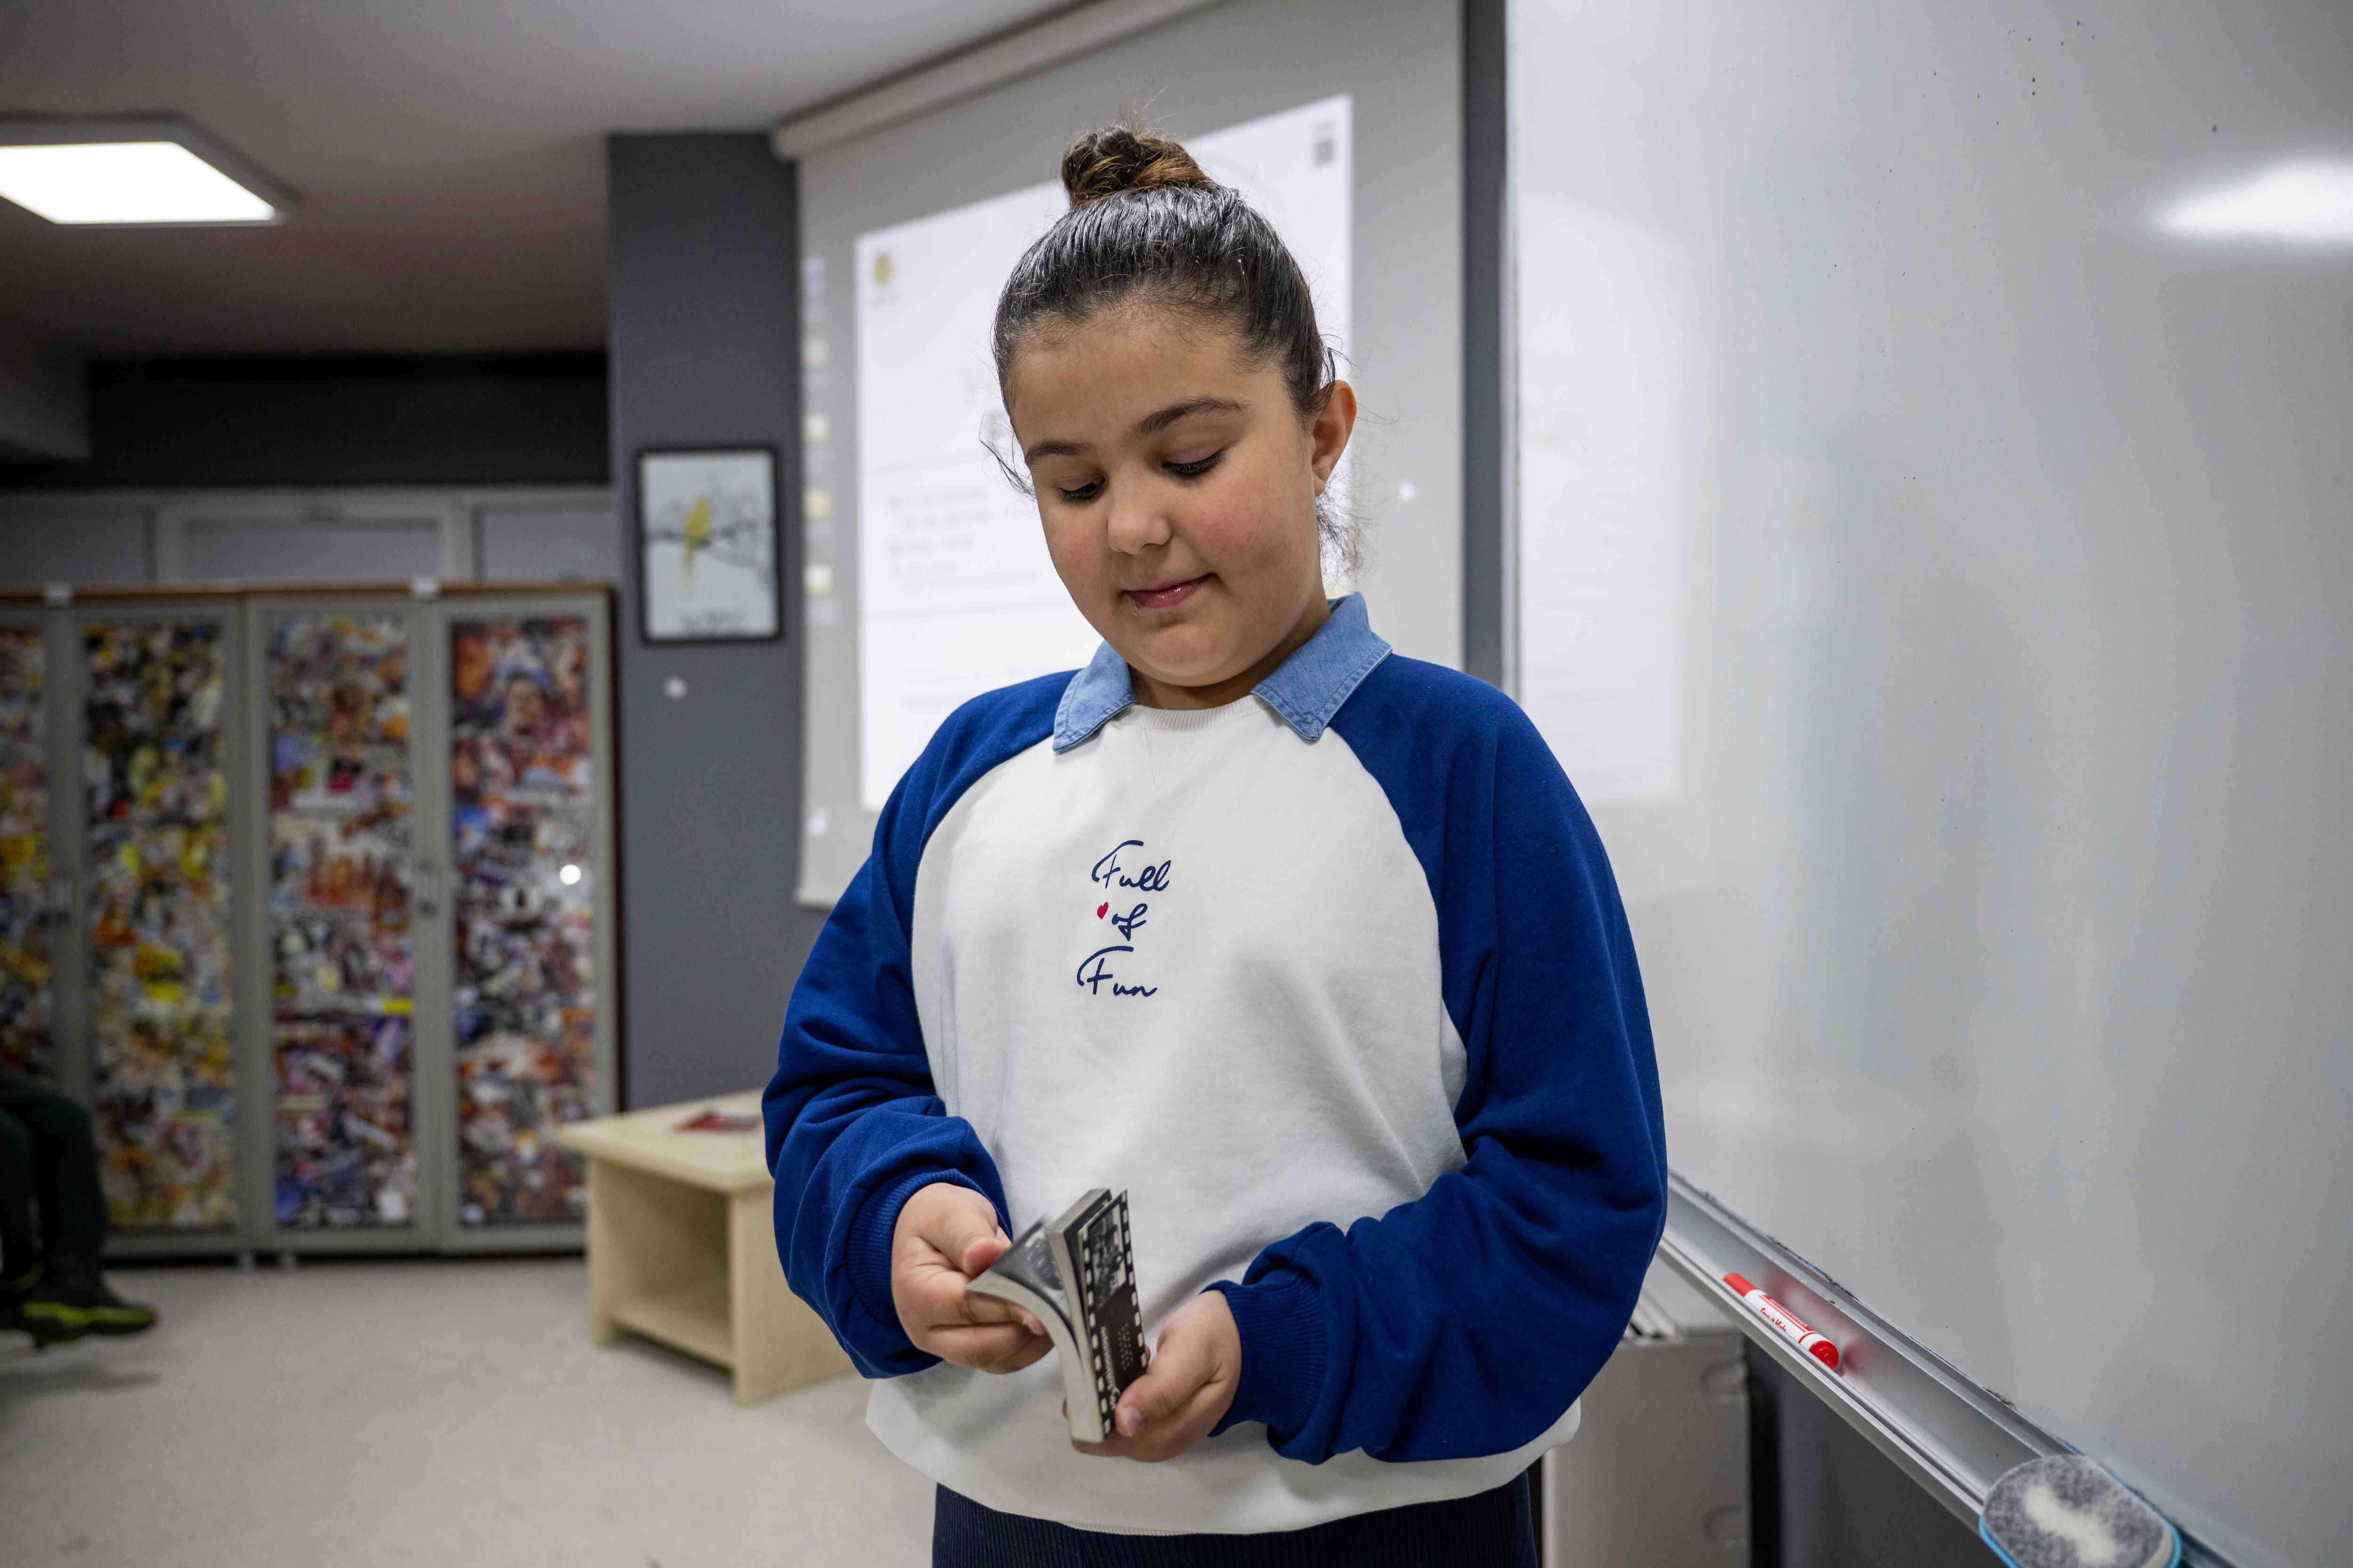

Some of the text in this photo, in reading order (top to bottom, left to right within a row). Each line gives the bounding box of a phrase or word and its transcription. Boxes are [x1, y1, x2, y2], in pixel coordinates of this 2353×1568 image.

[1092, 840, 1171, 891] Full
[1112, 904, 1148, 942] of
[1077, 946, 1157, 997] Fun
